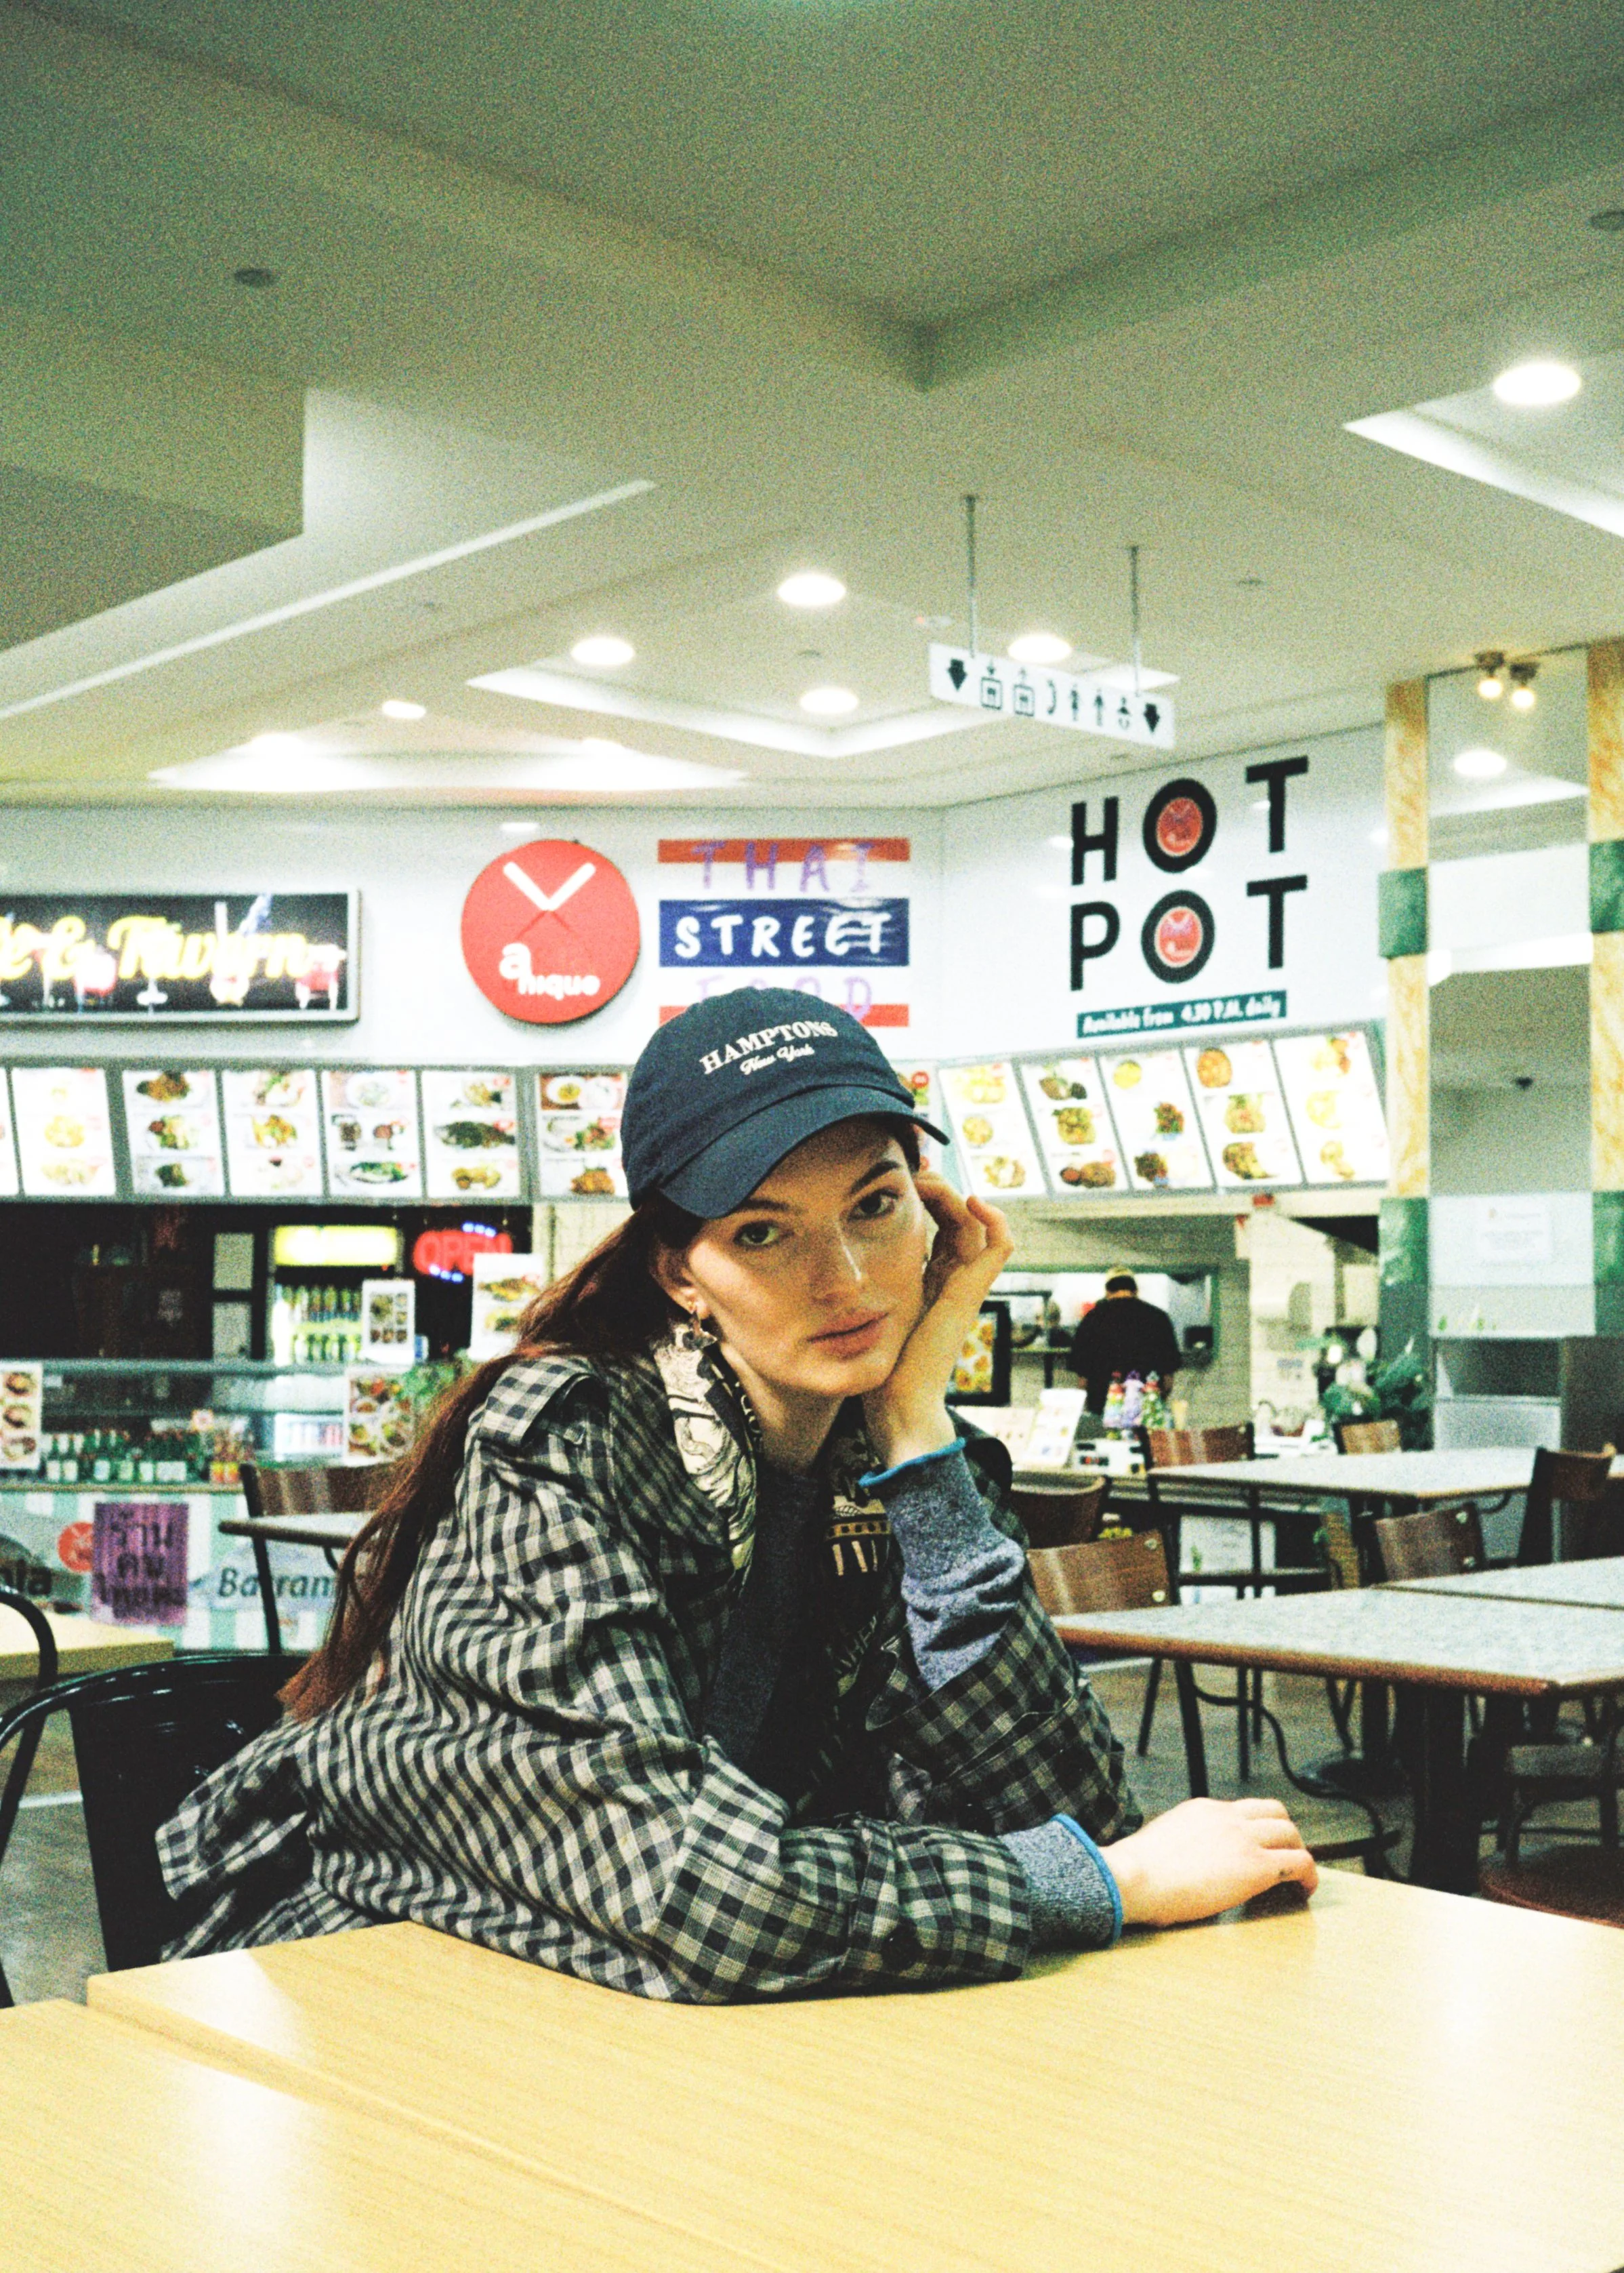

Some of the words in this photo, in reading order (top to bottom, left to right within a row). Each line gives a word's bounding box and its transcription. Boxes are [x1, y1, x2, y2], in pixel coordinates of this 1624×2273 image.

[1071, 755, 1308, 885] HOT
[691, 839, 875, 893] THAI
[674, 912, 892, 959] STREET
[1070, 874, 1308, 991] POT
[1083, 1010, 1141, 1035] Available
[1142, 1005, 1175, 1027] from
[1245, 994, 1283, 1019] daily
[699, 1020, 839, 1075] HAMPTONS
[739, 1054, 777, 1076] New
[776, 1043, 816, 1063] York
